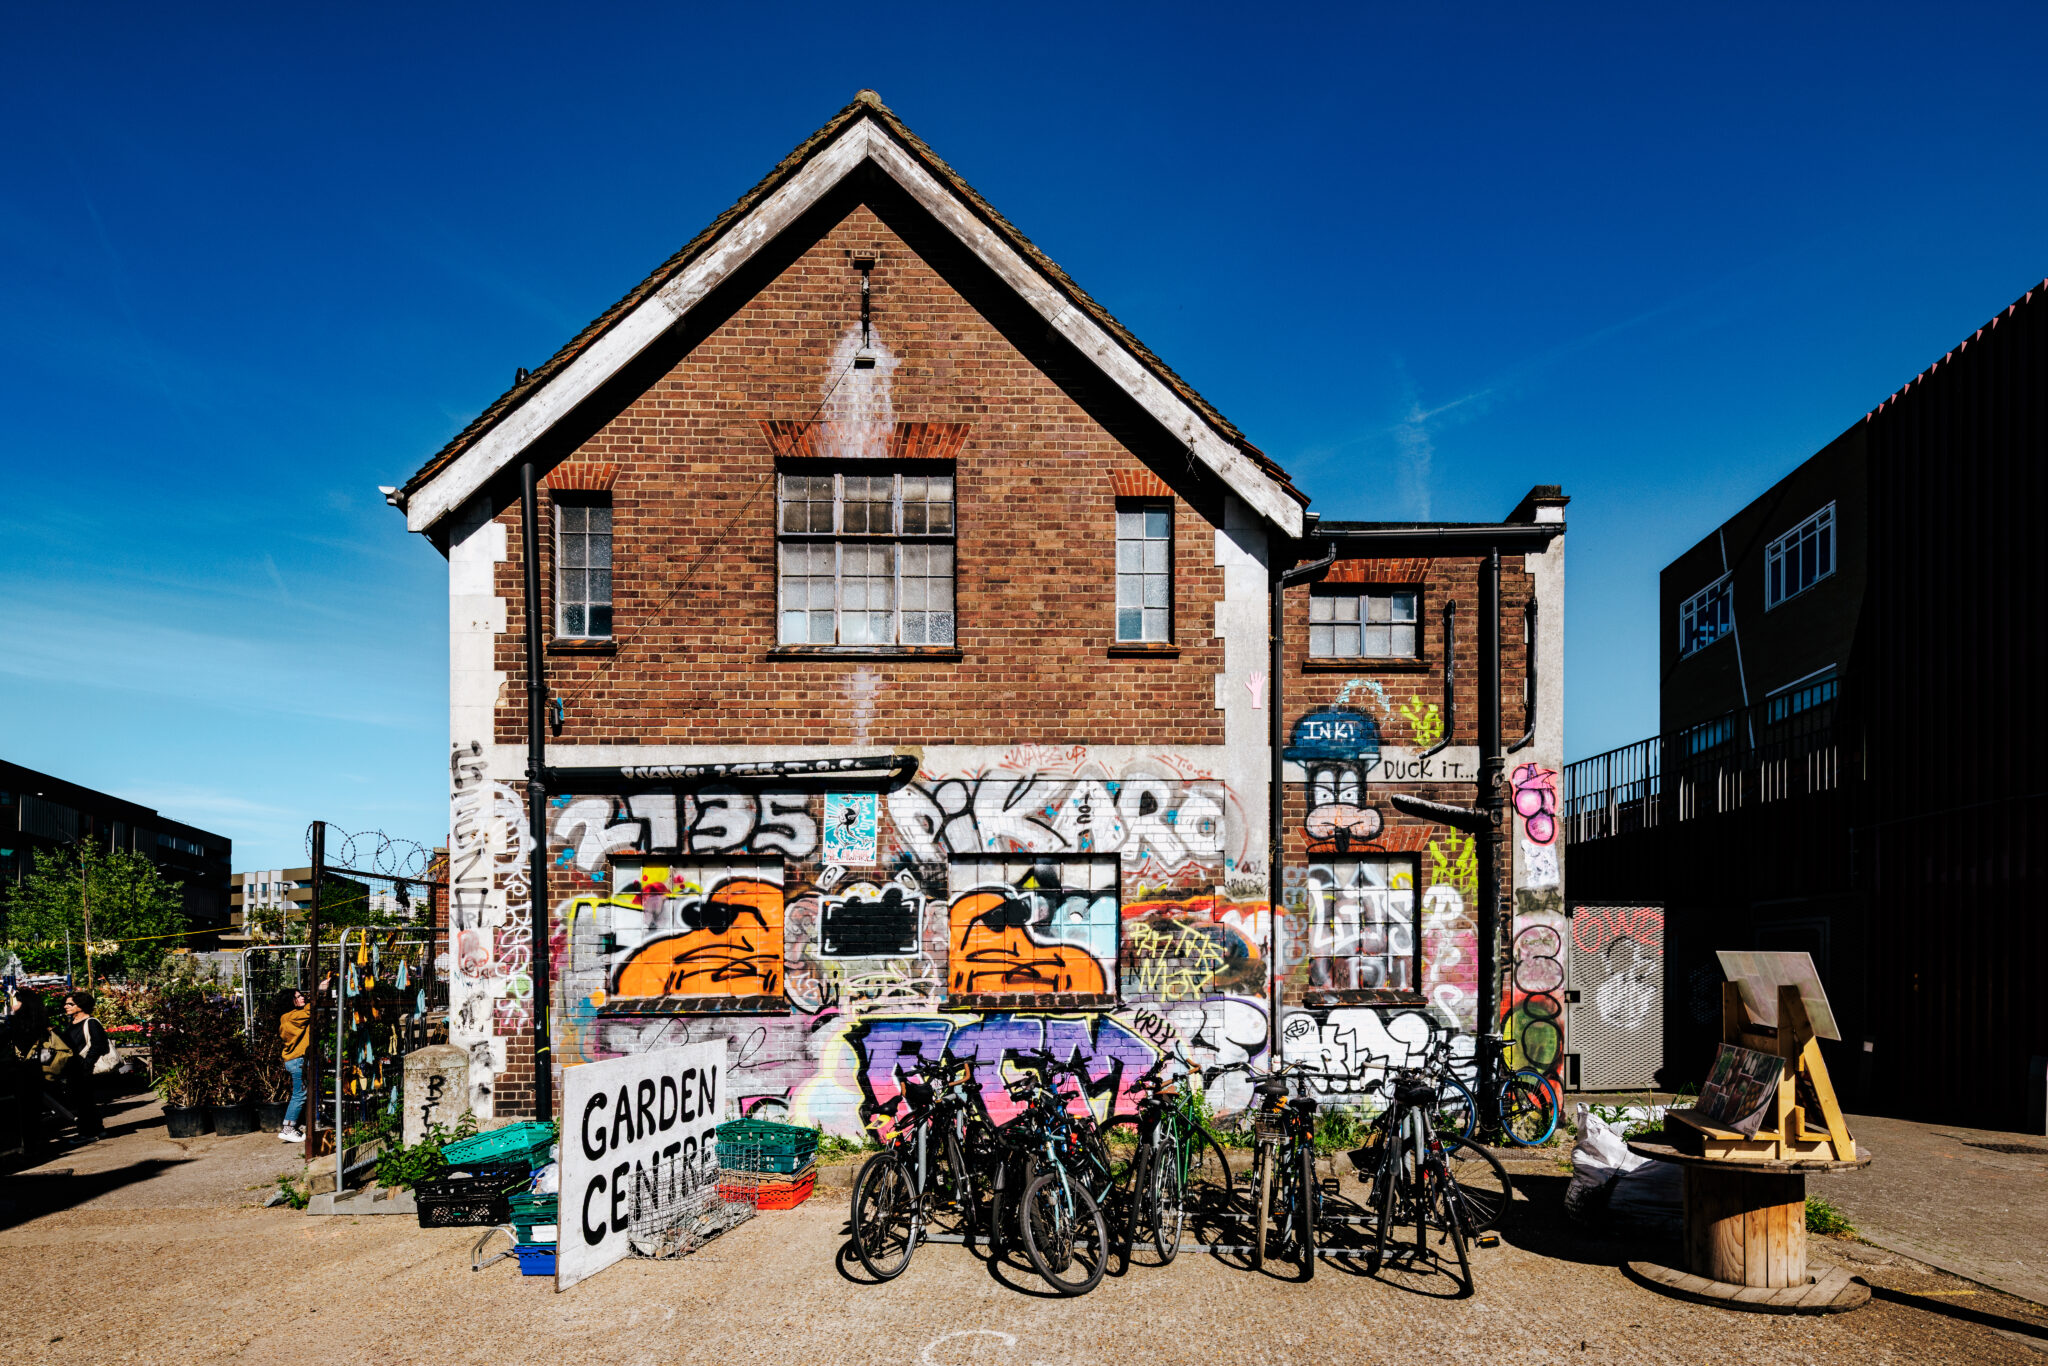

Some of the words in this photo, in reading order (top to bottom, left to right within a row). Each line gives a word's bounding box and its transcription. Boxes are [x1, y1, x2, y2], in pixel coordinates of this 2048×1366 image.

[1303, 721, 1356, 742] INK!
[1384, 760, 1432, 780] DUCK
[582, 1064, 718, 1161] GARDEN
[582, 1127, 716, 1246] CENTRE
